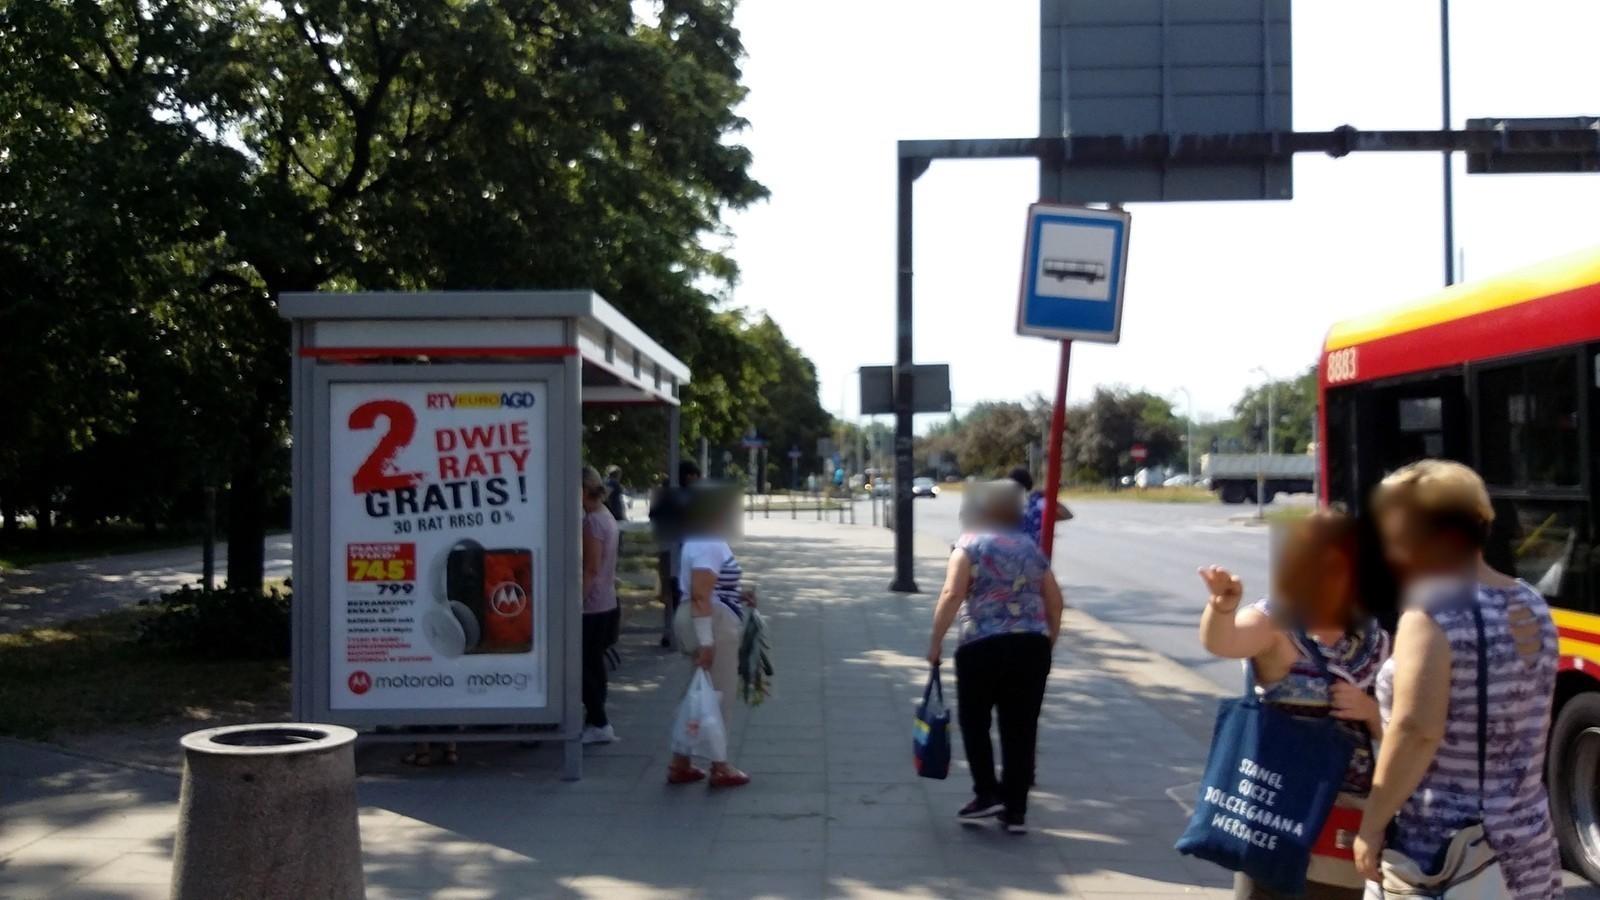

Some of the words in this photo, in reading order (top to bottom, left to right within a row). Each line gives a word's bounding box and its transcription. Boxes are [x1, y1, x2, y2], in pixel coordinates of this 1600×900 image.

[1328, 347, 1356, 383] 8883
[347, 399, 424, 495] 2
[435, 421, 531, 452] DWIE
[437, 448, 531, 481] RATY
[394, 519, 411, 534] 30
[418, 516, 444, 532] RAT
[450, 512, 484, 529] RRSO
[351, 560, 405, 581] 745
[376, 583, 414, 595] 799
[375, 673, 454, 689] motorola
[1239, 758, 1283, 790] SZANEL
[1238, 778, 1277, 807] GUCZI
[1204, 786, 1304, 837] DOLCZEGABANA
[1211, 812, 1278, 851] WERSACZE
